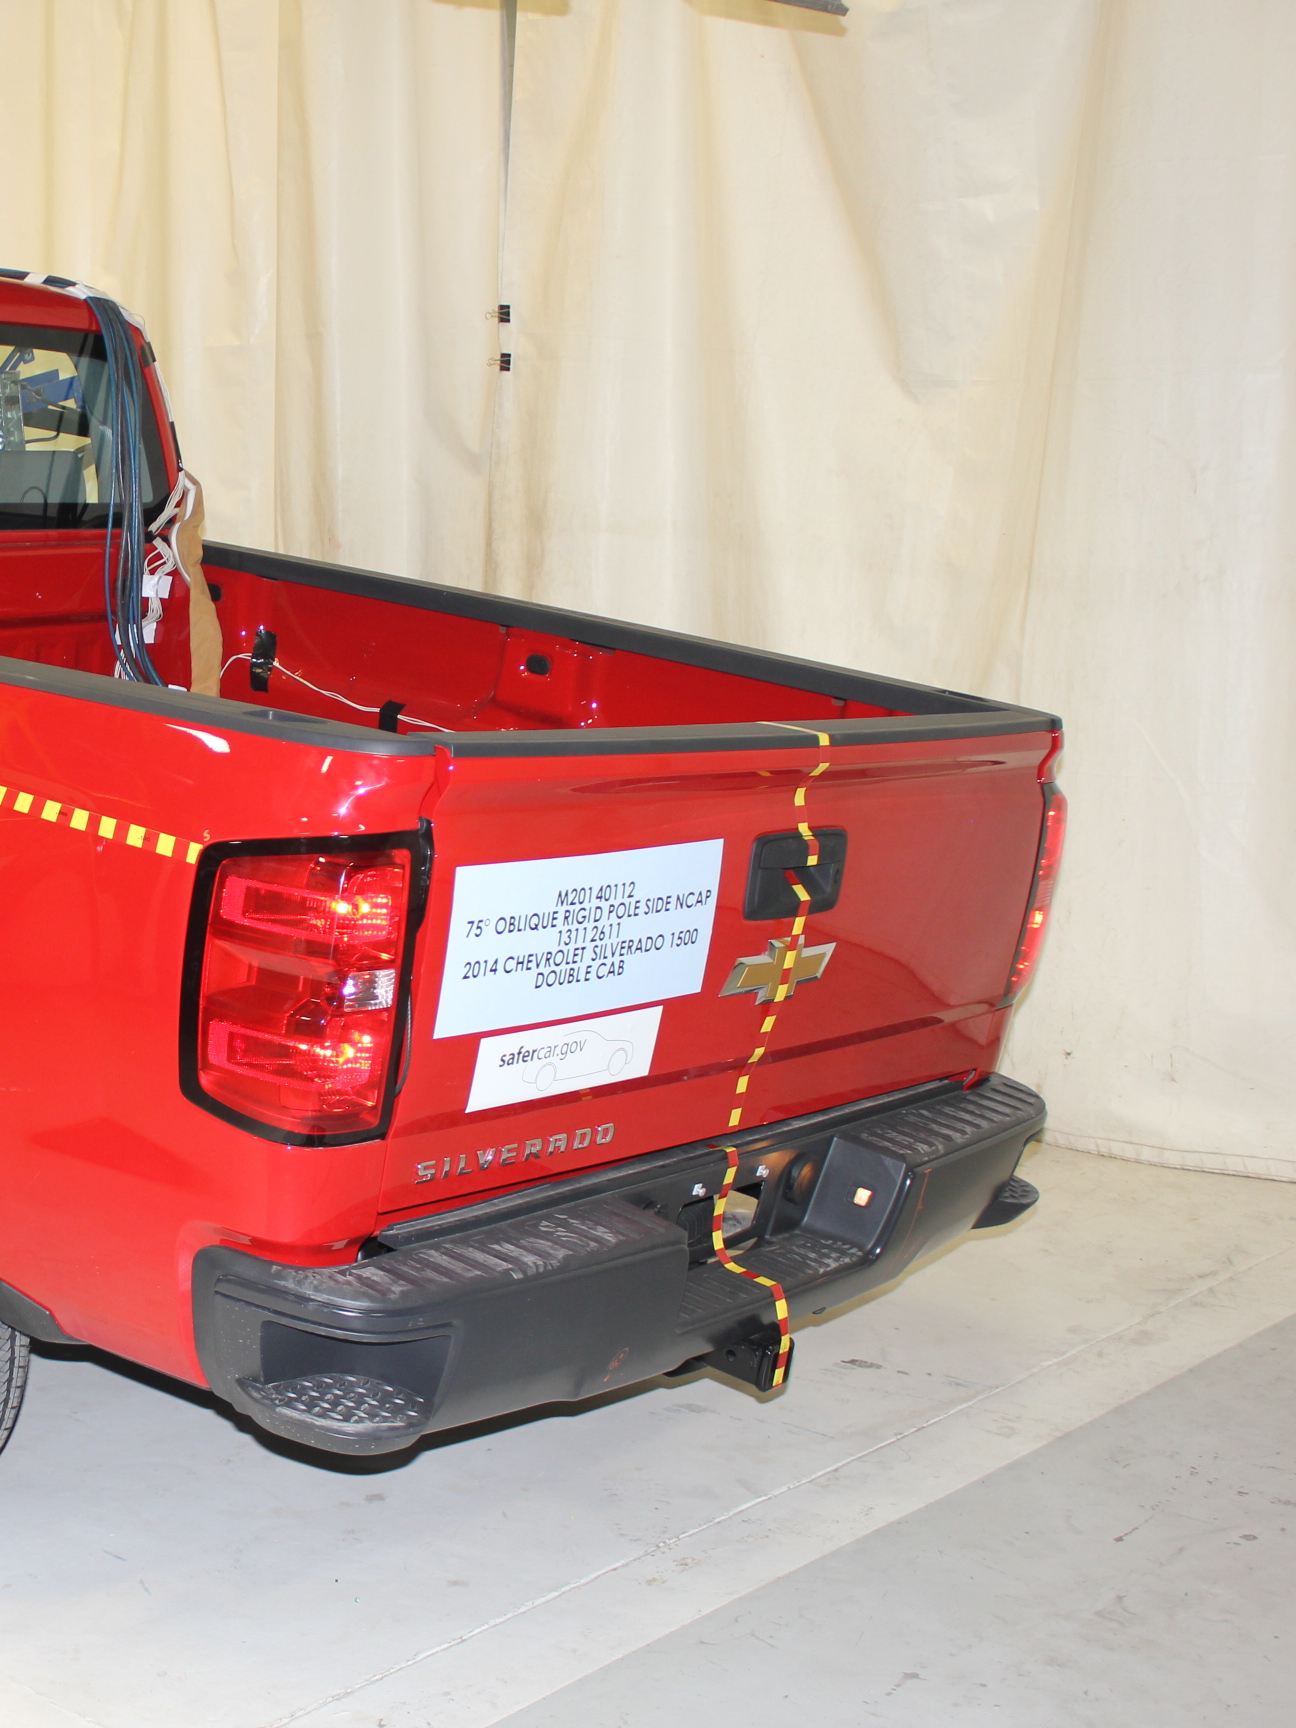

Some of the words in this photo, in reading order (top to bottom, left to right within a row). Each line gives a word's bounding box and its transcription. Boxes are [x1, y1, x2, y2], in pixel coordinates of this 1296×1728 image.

[555, 881, 636, 908] M20140112
[495, 910, 559, 935] OBLIQUE
[562, 906, 603, 926] RIGID
[607, 900, 641, 921] POLE
[644, 895, 672, 916] SIDE
[675, 889, 712, 910] NCAP
[557, 922, 621, 947] 13112611
[462, 957, 499, 980] 2014
[503, 946, 587, 974] CHEVROLET
[591, 934, 665, 962] SILVERADO
[670, 928, 699, 949] 1500
[534, 965, 593, 989] DOUBLE
[595, 959, 625, 980] CAB
[498, 1038, 587, 1068] safercar.gov
[414, 1122, 615, 1184] SILVERADO
